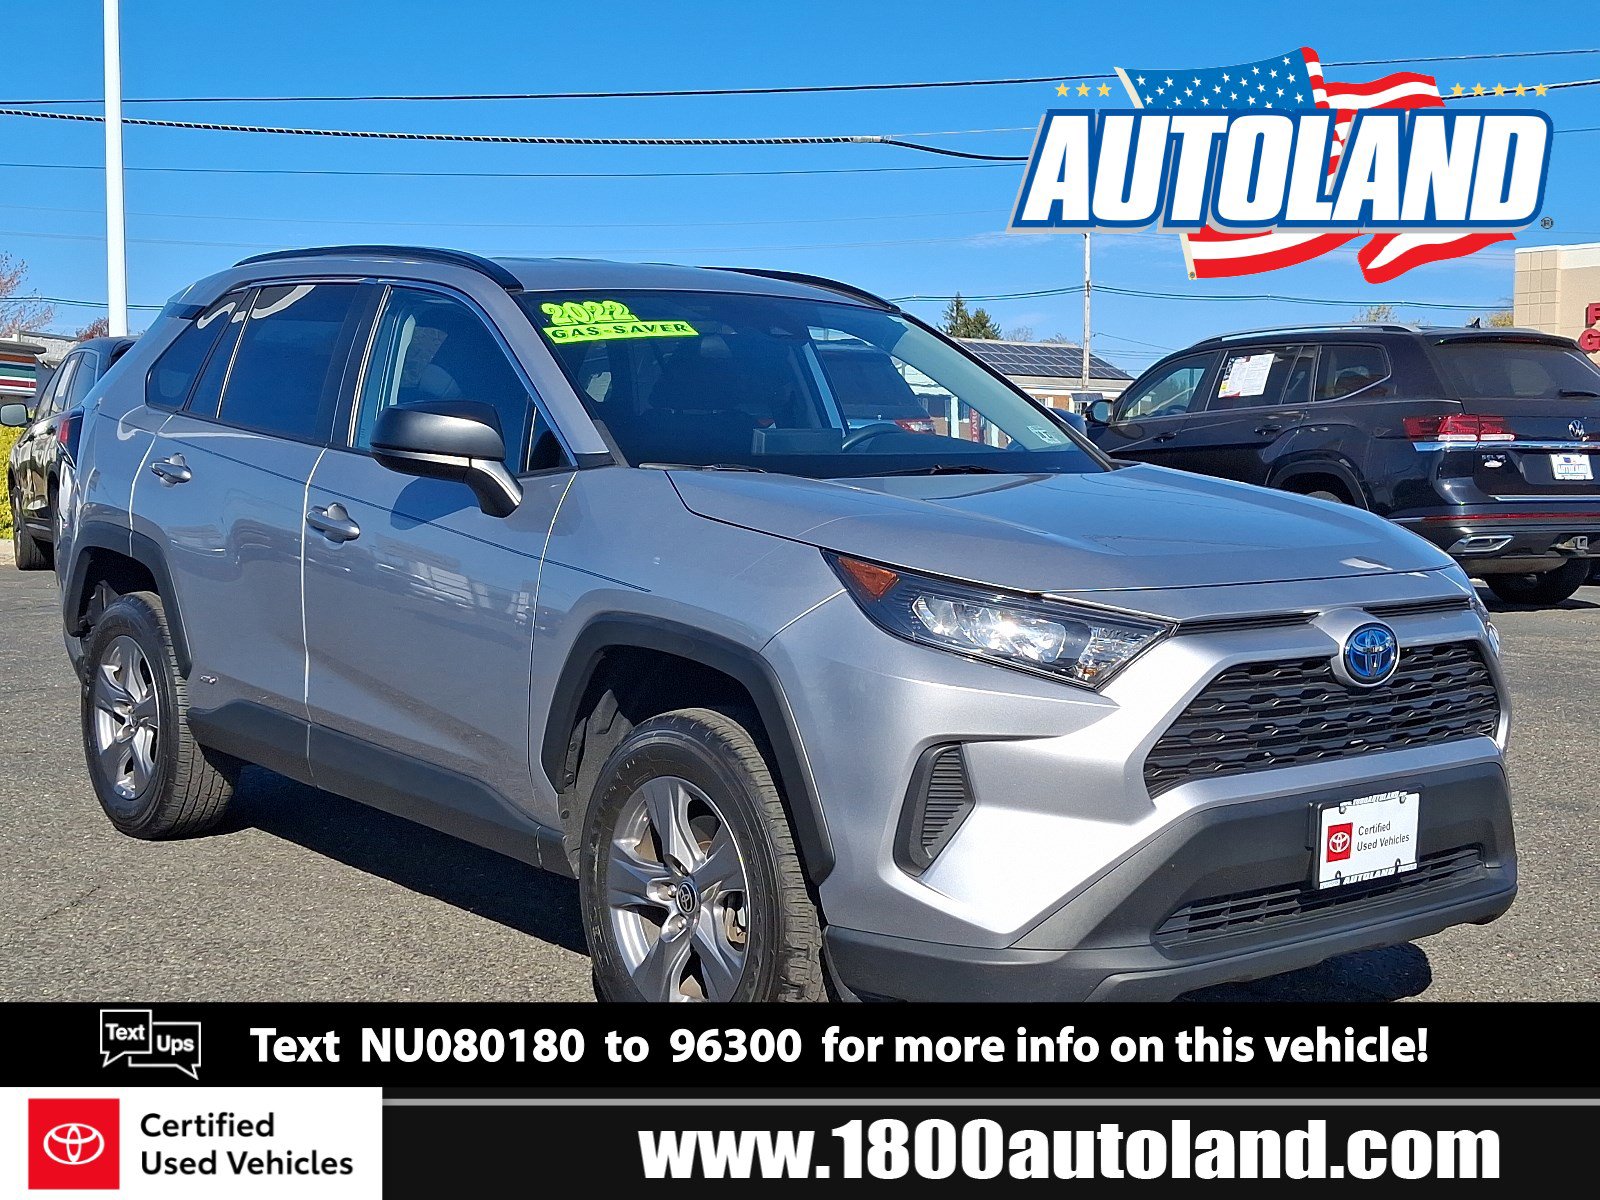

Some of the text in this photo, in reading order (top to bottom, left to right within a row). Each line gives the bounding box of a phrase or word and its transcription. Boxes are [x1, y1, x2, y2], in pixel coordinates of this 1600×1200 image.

[541, 300, 640, 326] 2022
[1358, 820, 1391, 836] Certified
[1356, 833, 1410, 852] Used Vehicles
[1343, 867, 1396, 885] AUTOLAND
